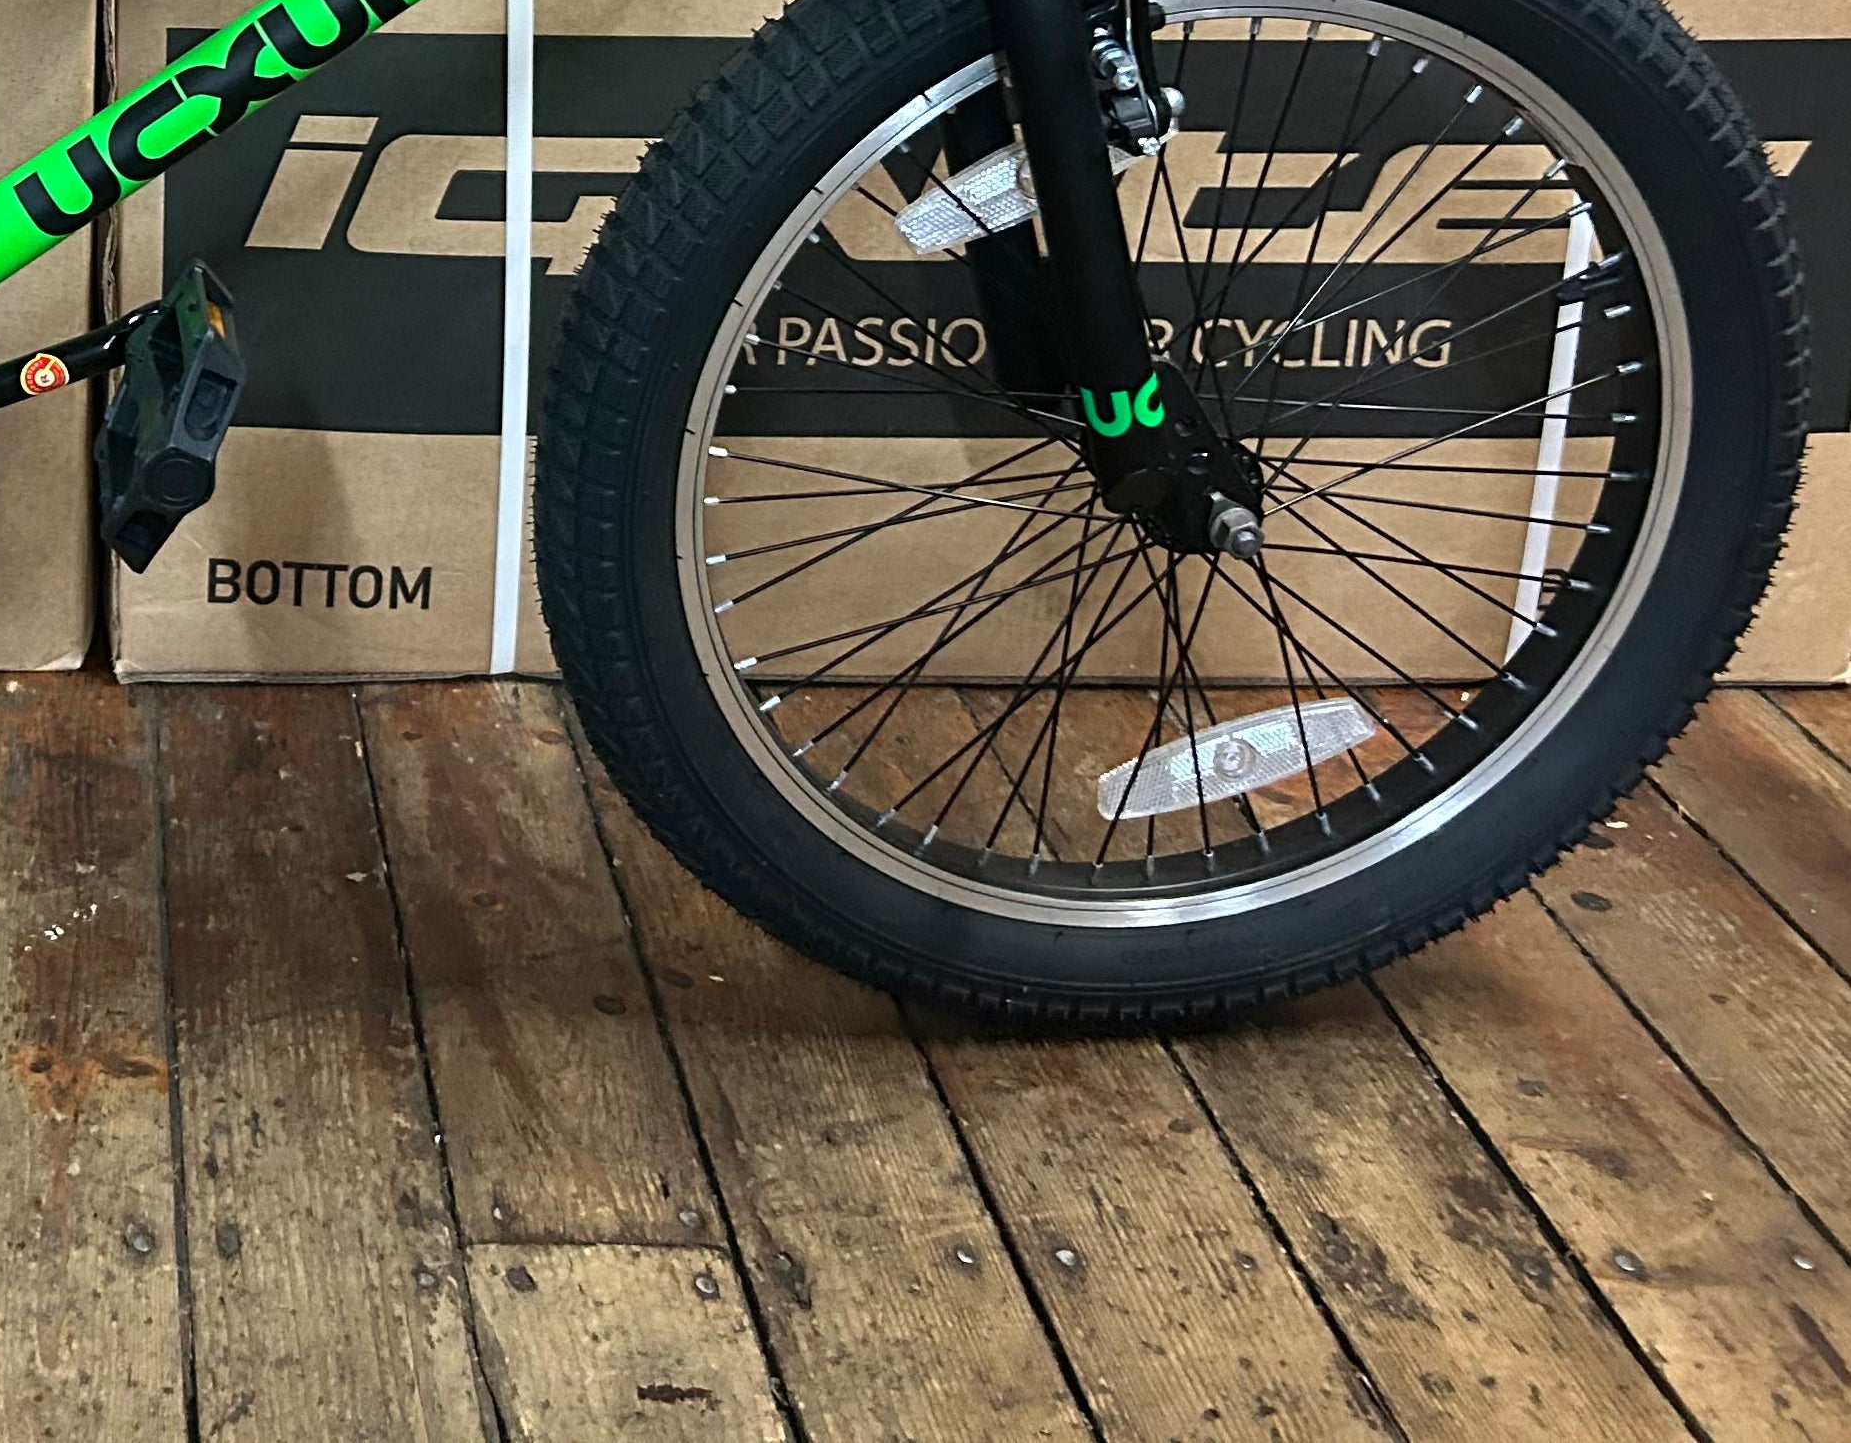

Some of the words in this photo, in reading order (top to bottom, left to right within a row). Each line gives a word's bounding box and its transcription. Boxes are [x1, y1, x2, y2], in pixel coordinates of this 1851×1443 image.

[777, 316, 988, 368] PASSIO
[1191, 318, 1453, 369] CYCLING
[207, 558, 433, 611] BOTTOM
